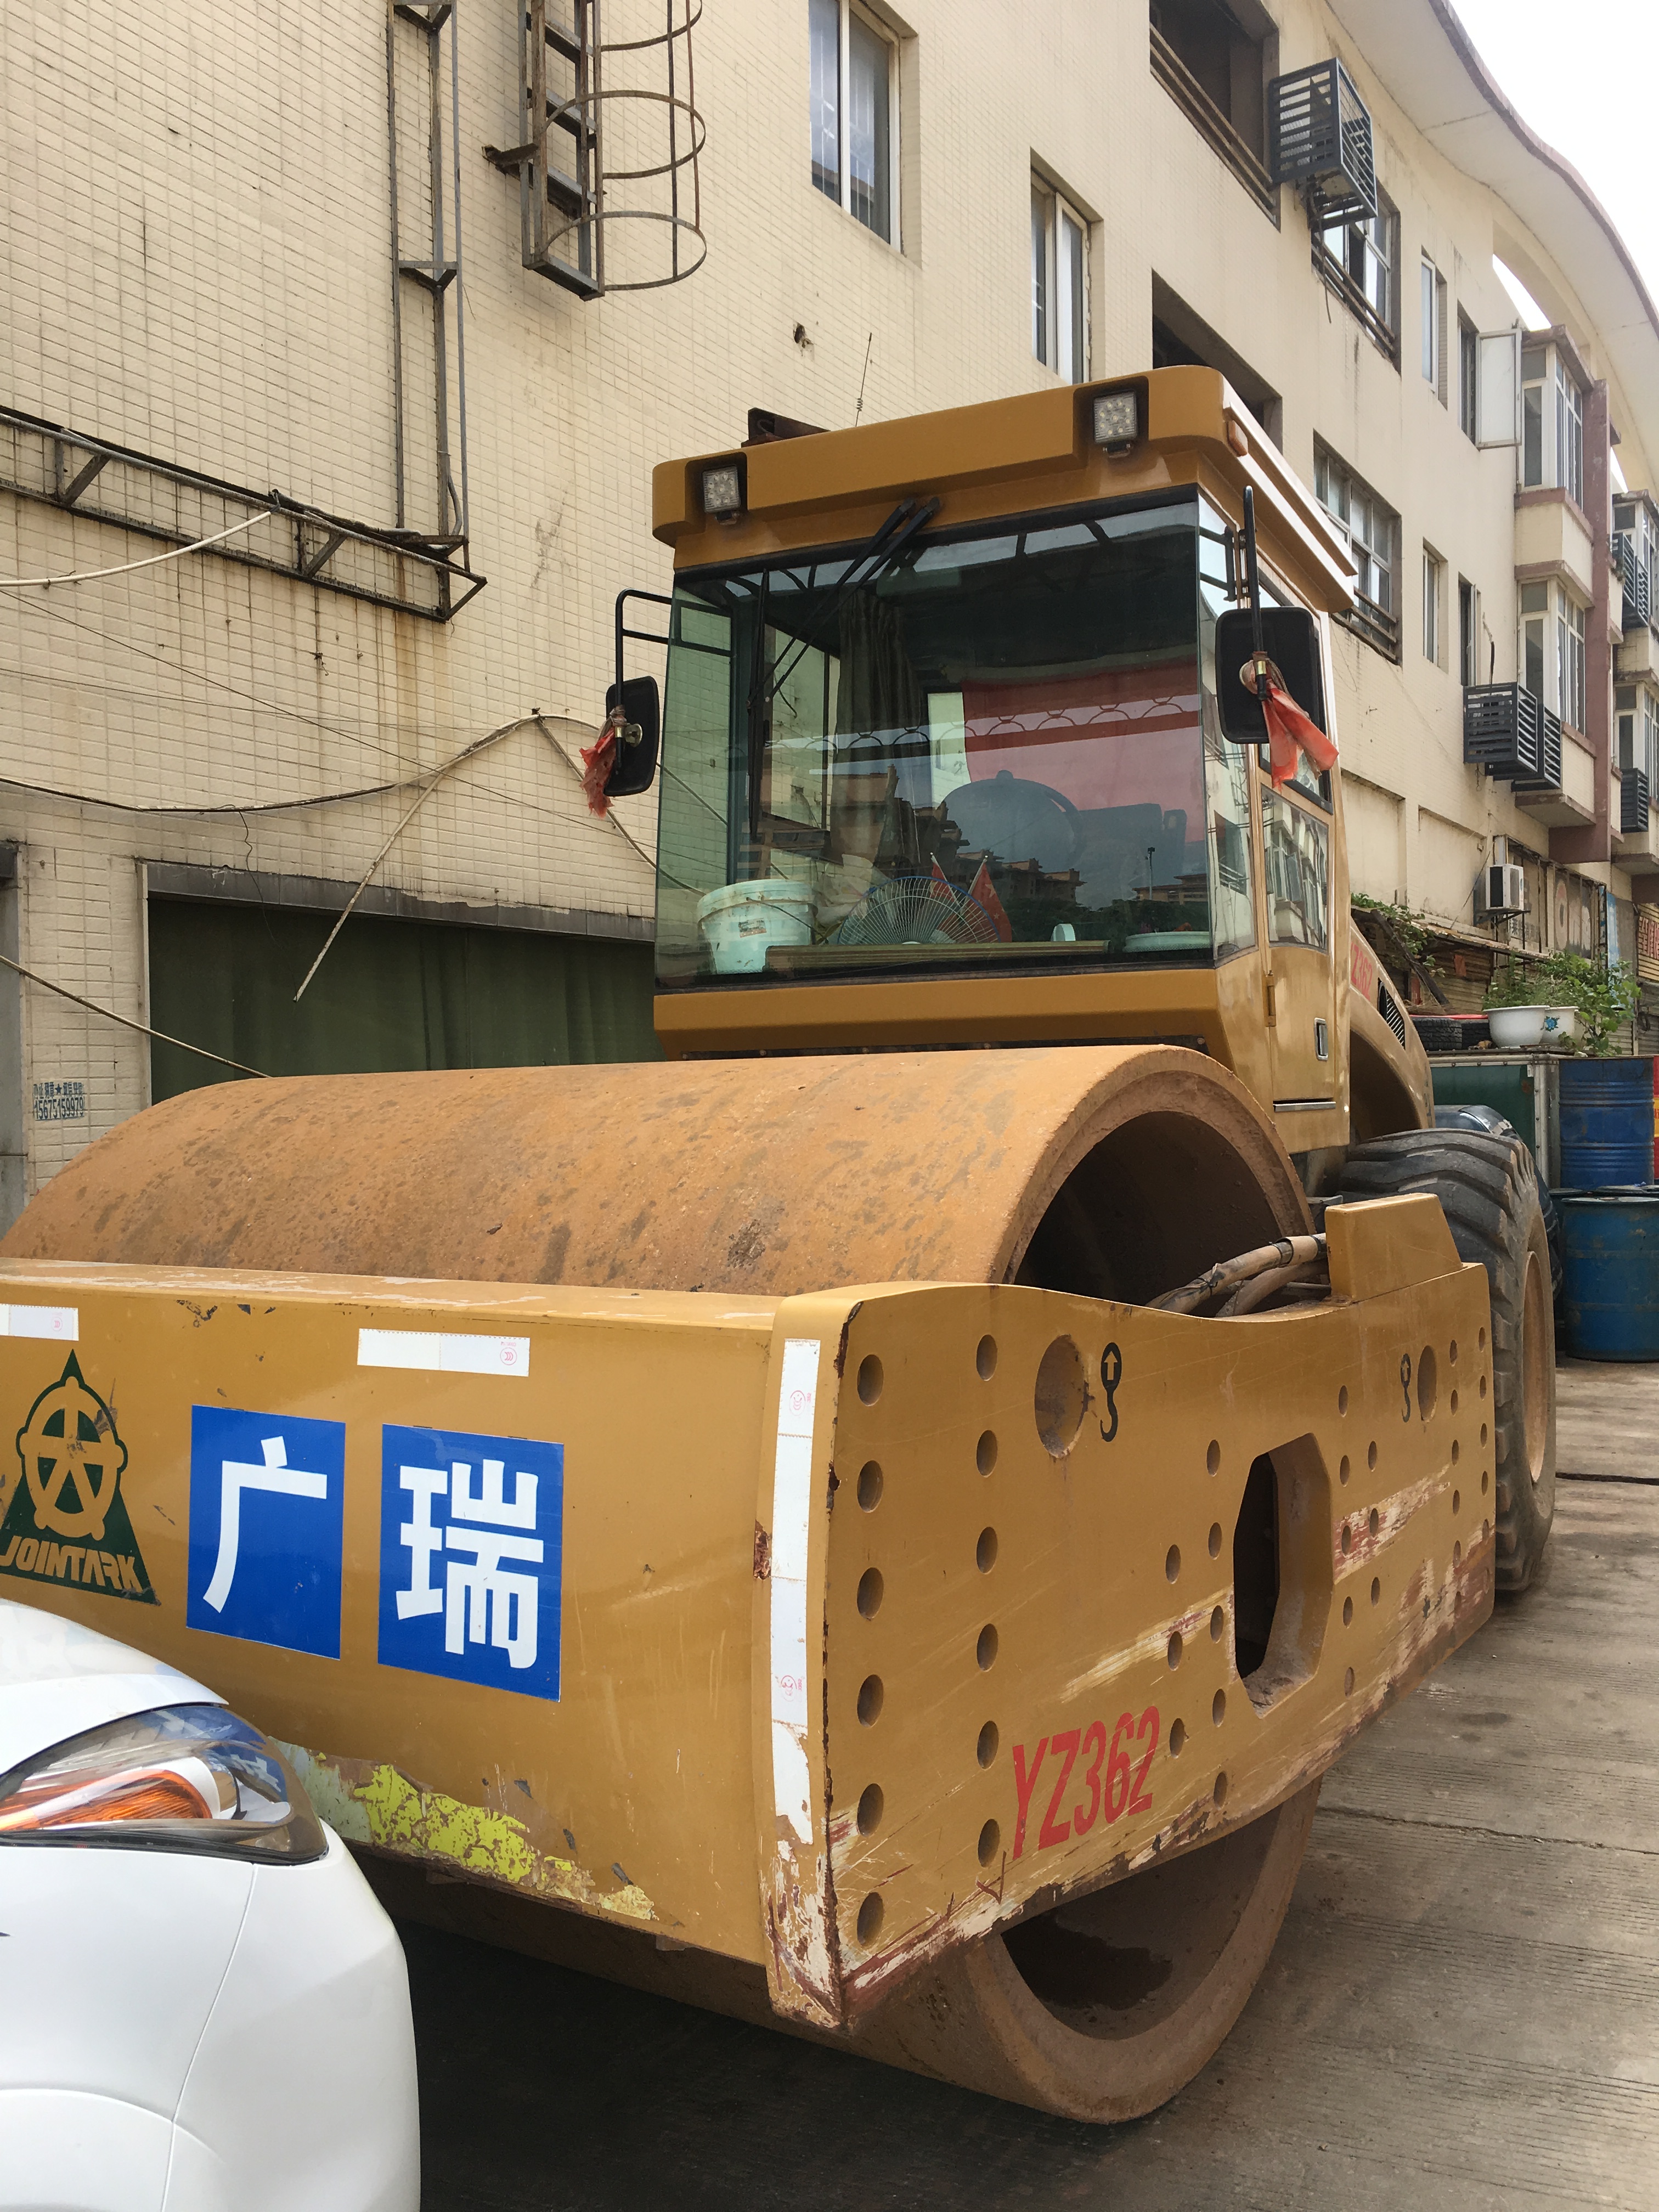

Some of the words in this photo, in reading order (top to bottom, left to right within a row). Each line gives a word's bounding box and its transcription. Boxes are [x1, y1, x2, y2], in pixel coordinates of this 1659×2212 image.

[1350, 941, 1373, 1001] Z362
[0, 1535, 144, 1594] JOINTARK
[203, 1435, 544, 1669] 广瑞
[1012, 1705, 1160, 1860] YZ362
